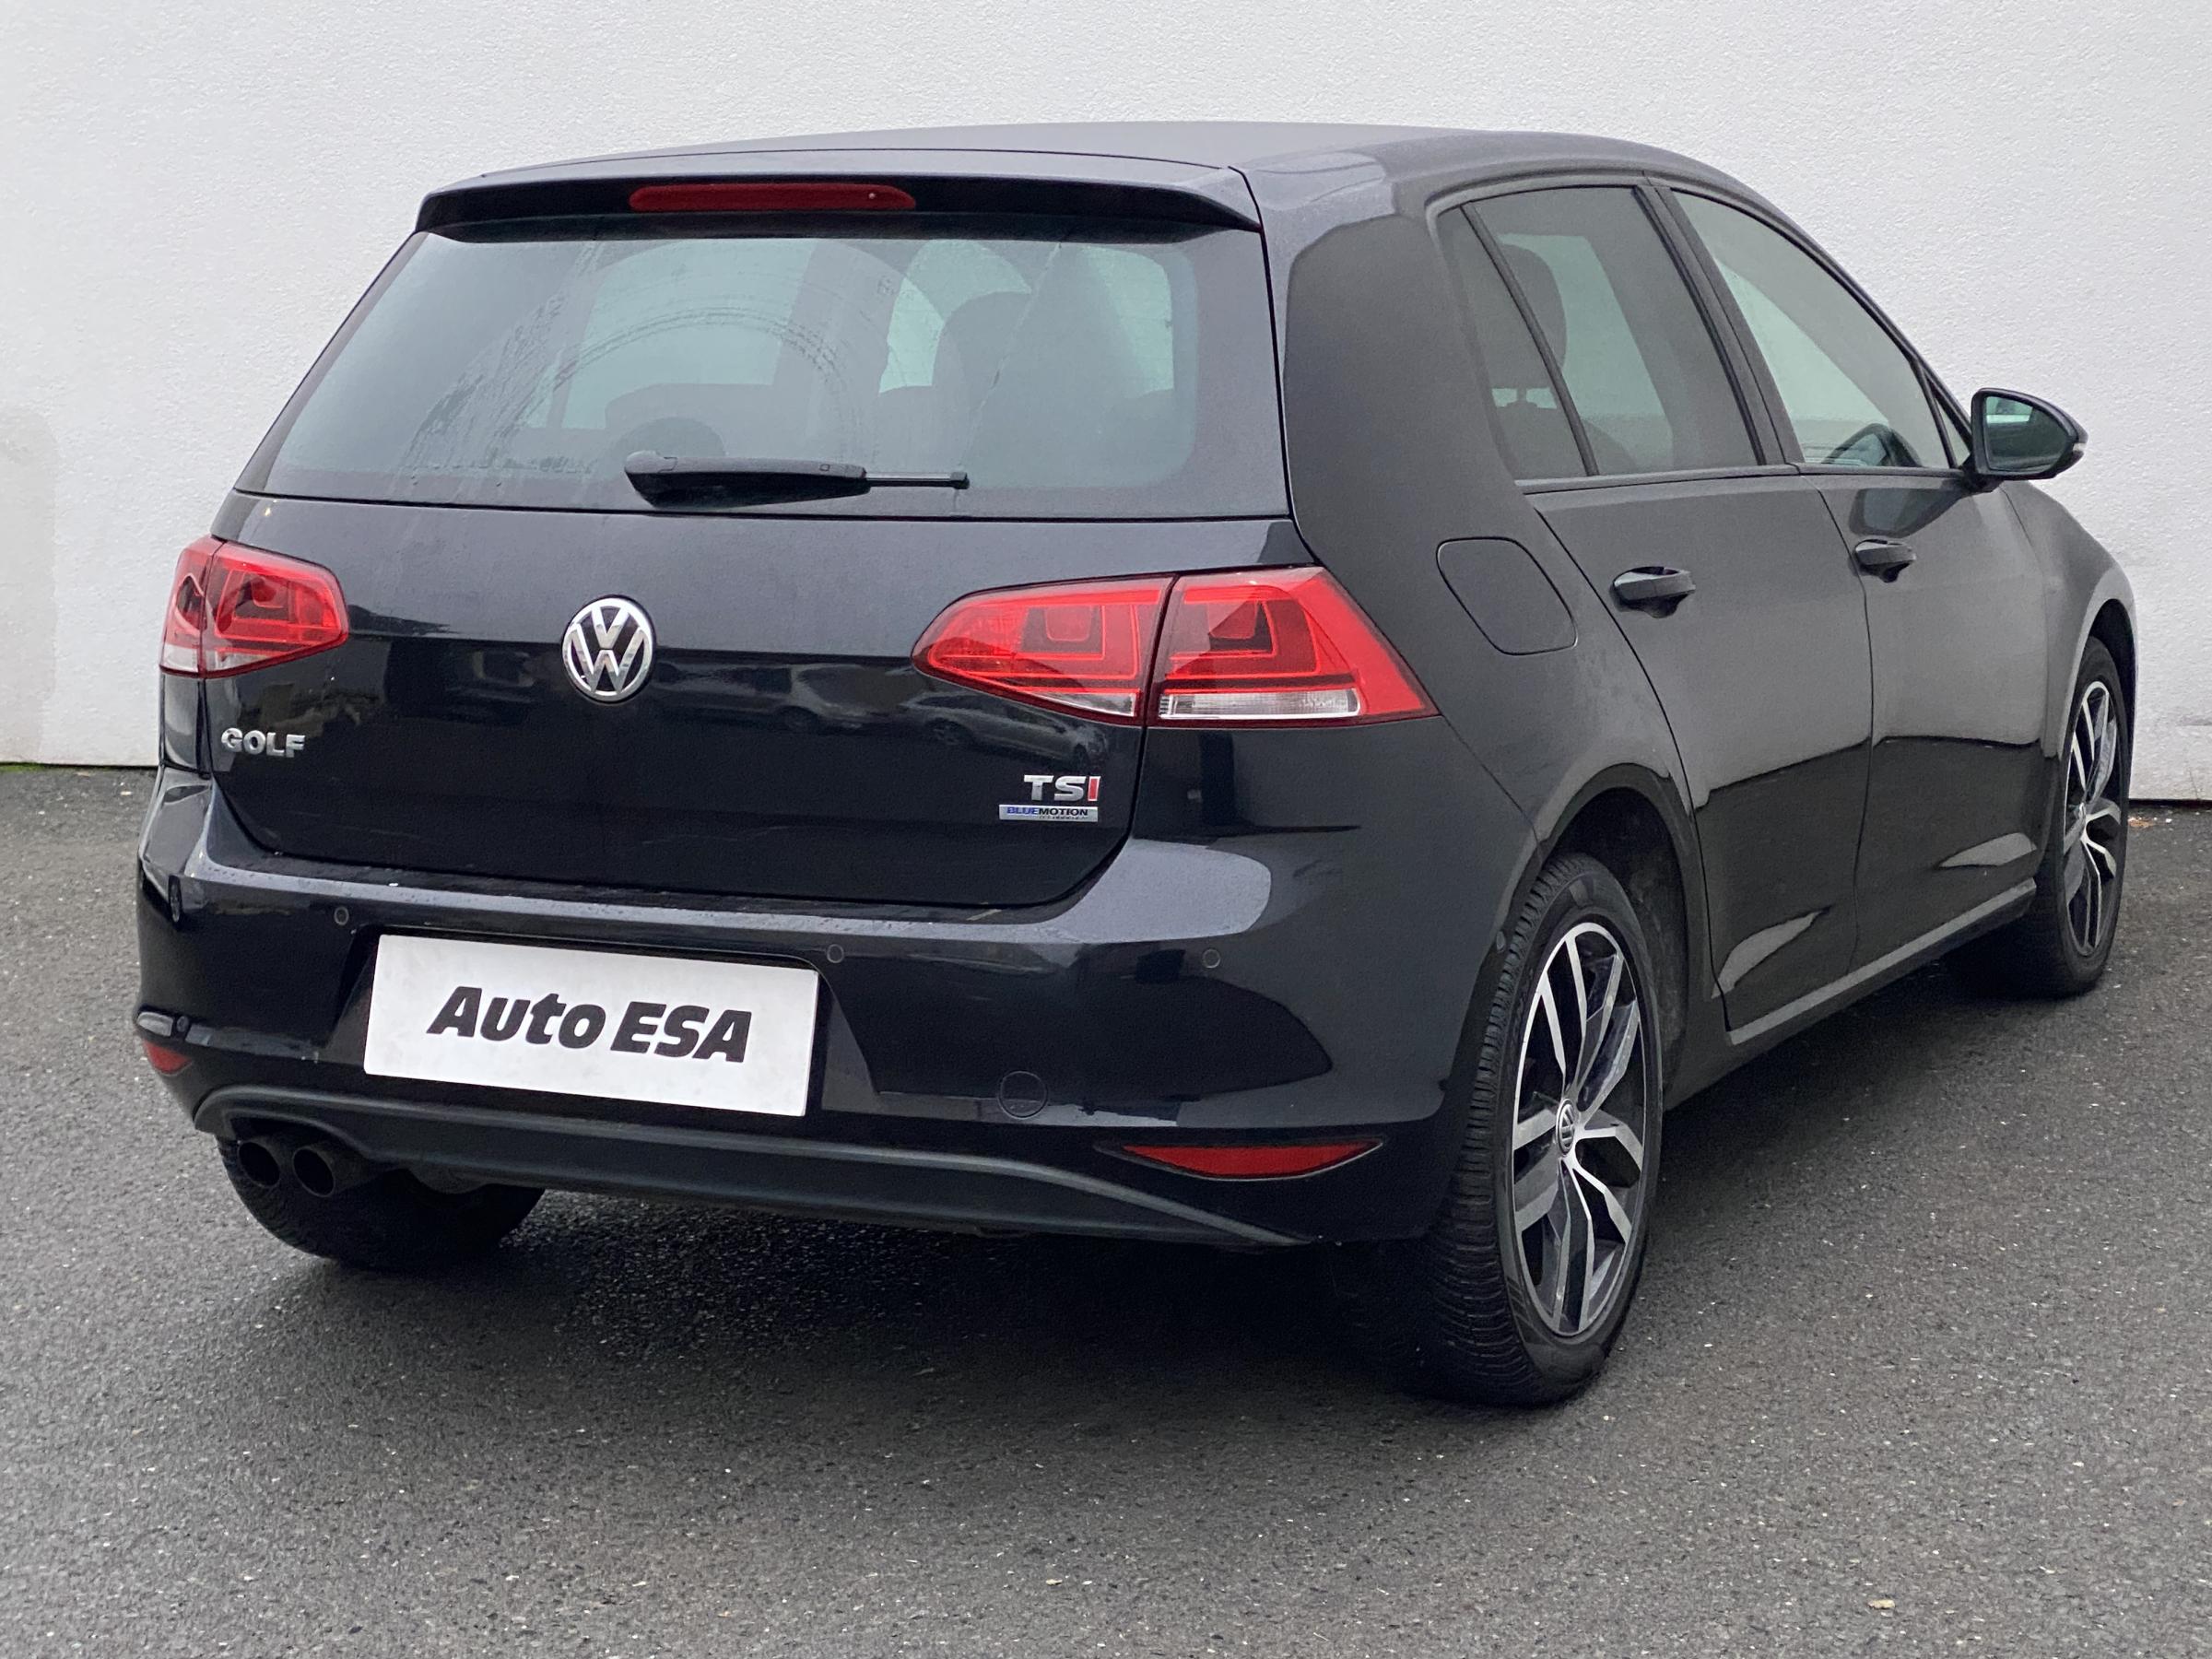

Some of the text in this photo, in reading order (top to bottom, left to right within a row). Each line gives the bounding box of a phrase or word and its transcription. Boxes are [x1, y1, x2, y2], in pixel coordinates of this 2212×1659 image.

[562, 598, 653, 700] VW
[221, 727, 305, 758] GOLF
[1023, 775, 1101, 801] TSI
[1006, 806, 1088, 816] BLUEMOTION
[426, 985, 753, 1064] Auto ESA
